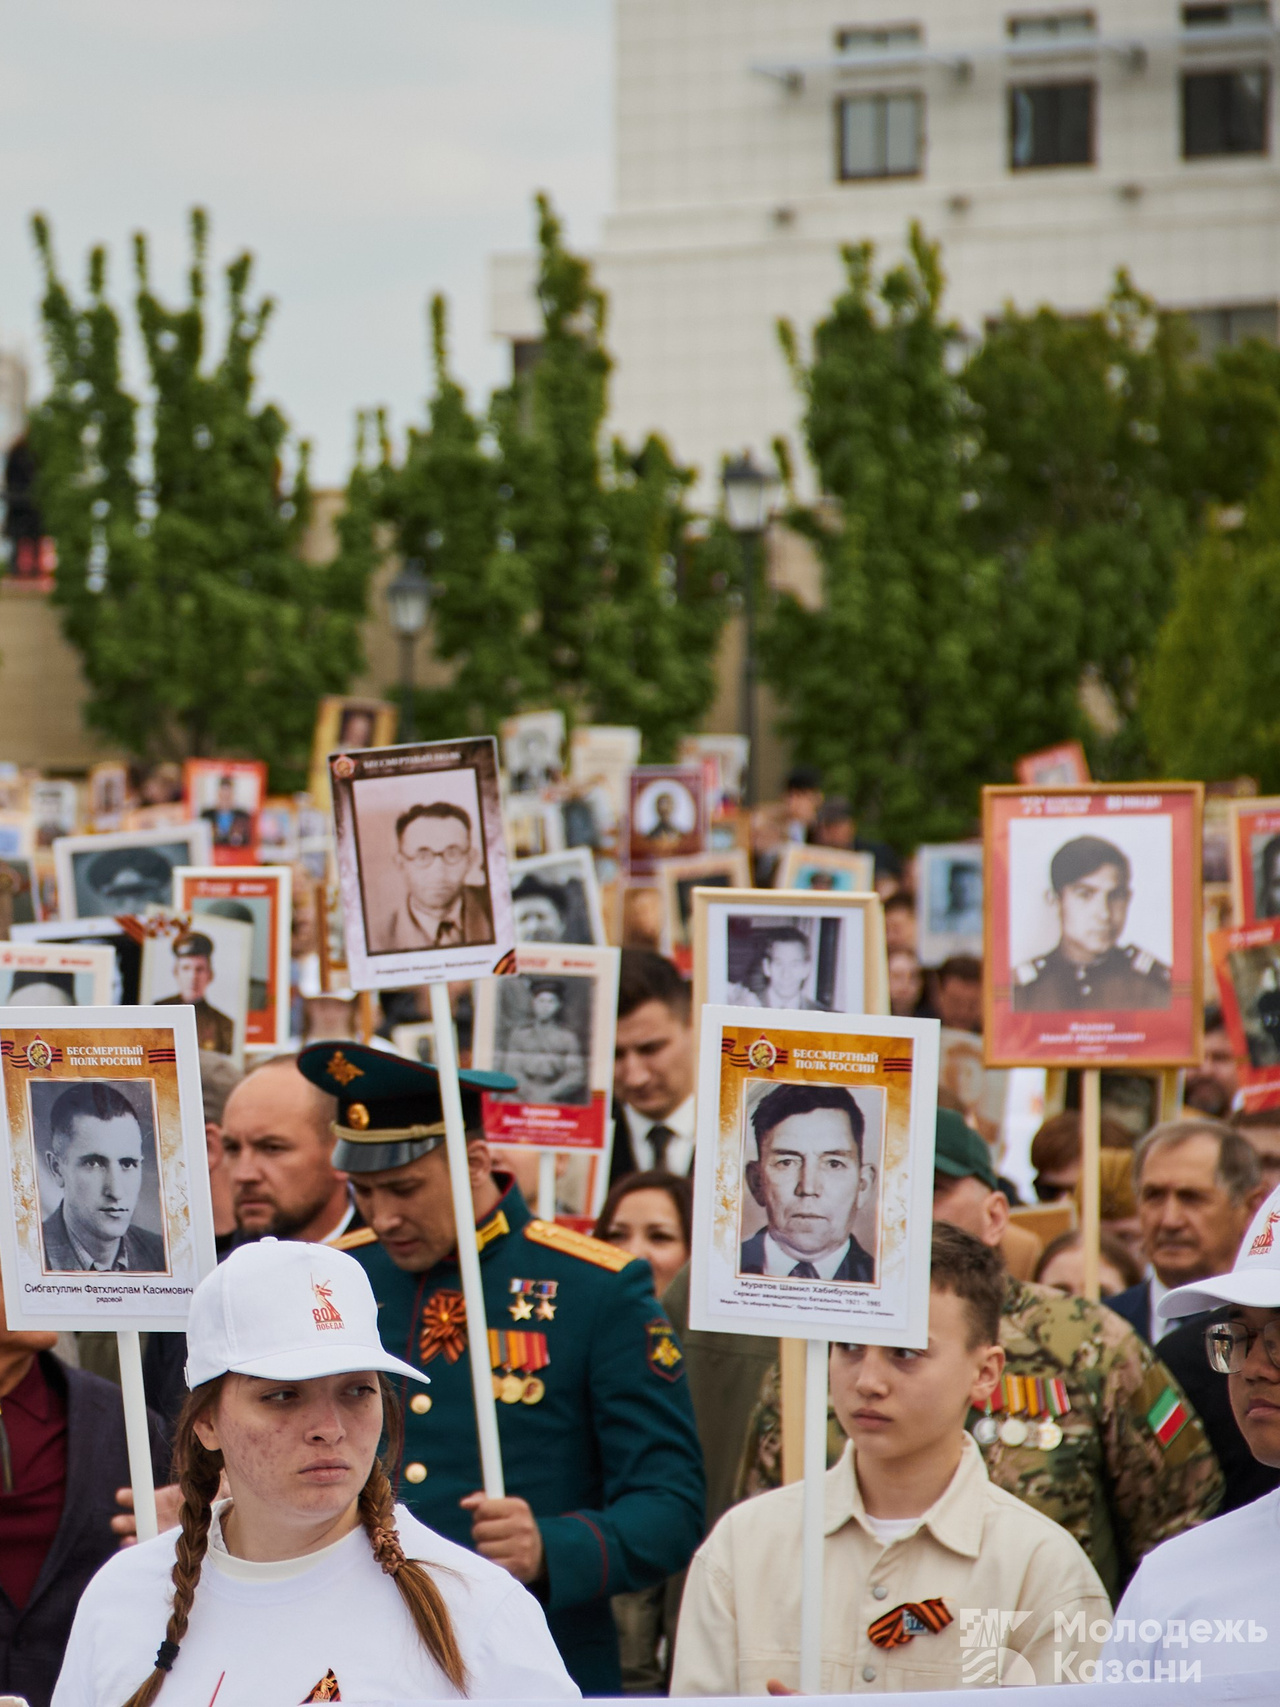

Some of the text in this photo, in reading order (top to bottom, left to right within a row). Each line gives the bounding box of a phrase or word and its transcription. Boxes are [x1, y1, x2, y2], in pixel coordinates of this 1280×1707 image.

[66, 1045, 144, 1055] БЕССМЕРТНЫЙ
[793, 1048, 879, 1063] БЕССМЕРТНЫЙ
[70, 1057, 142, 1066] ПОЛК РОССИИ
[795, 1060, 875, 1073] ПОЛК РОССИИ
[24, 1283, 194, 1295] Сибгатуллин Фатхлислам Касимович
[733, 1290, 760, 1299] Сержант
[740, 1281, 870, 1298] Муратов Шамил Хабибулович
[312, 1307, 330, 1322] 80
[316, 1322, 345, 1331] ПОБЕДА!
